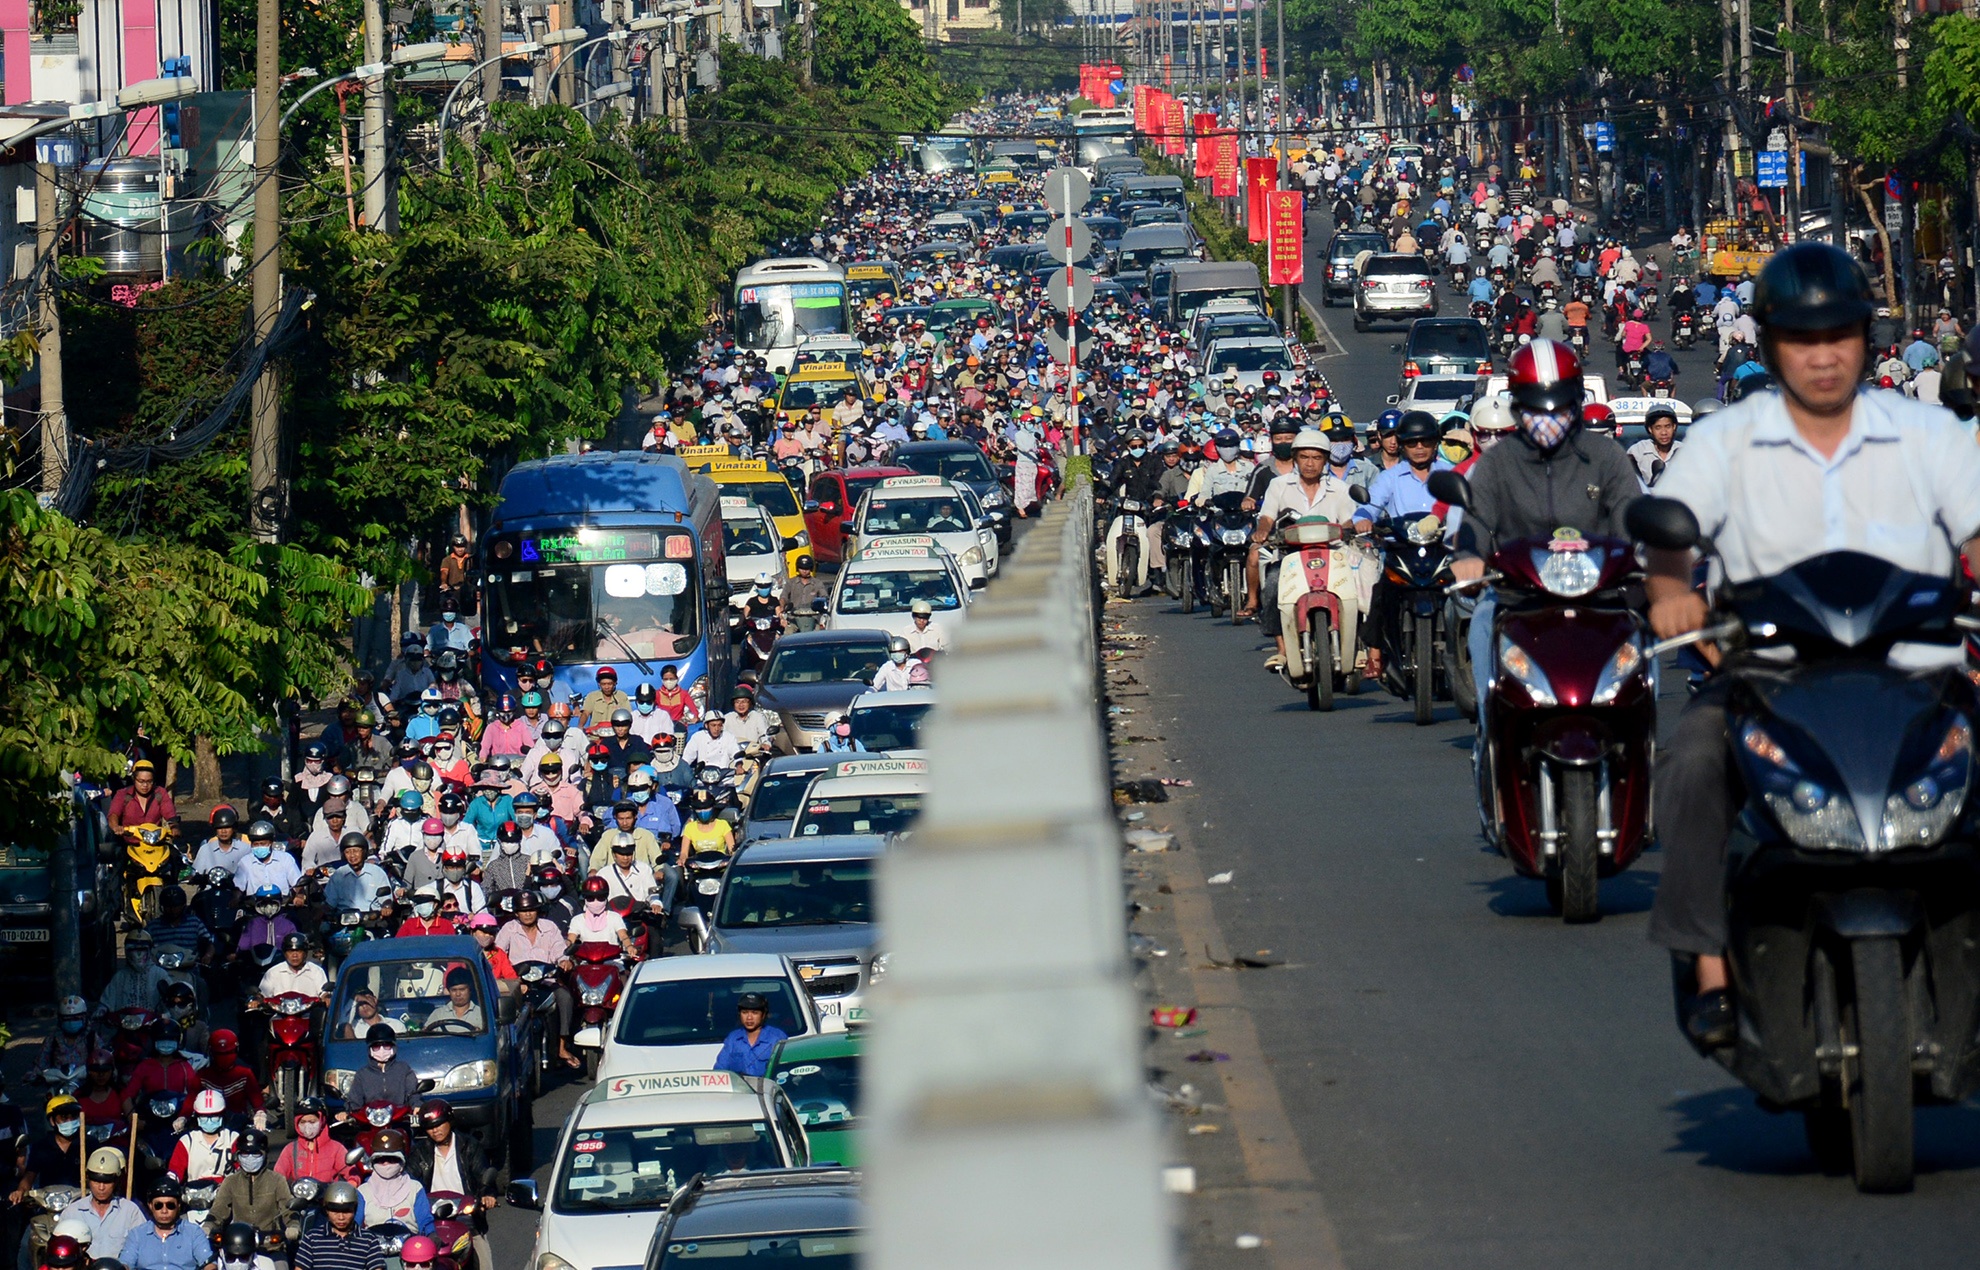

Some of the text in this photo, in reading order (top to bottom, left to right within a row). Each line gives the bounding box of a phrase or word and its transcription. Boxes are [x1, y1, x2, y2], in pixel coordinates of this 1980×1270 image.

[742, 289, 756, 303] 04
[803, 363, 842, 371] Vinataxi
[1616, 401, 1629, 410] 38
[1632, 401, 1644, 410] 21
[681, 446, 724, 454] Vinataxi
[667, 536, 691, 555] 104
[575, 1141, 603, 1151] 3956
